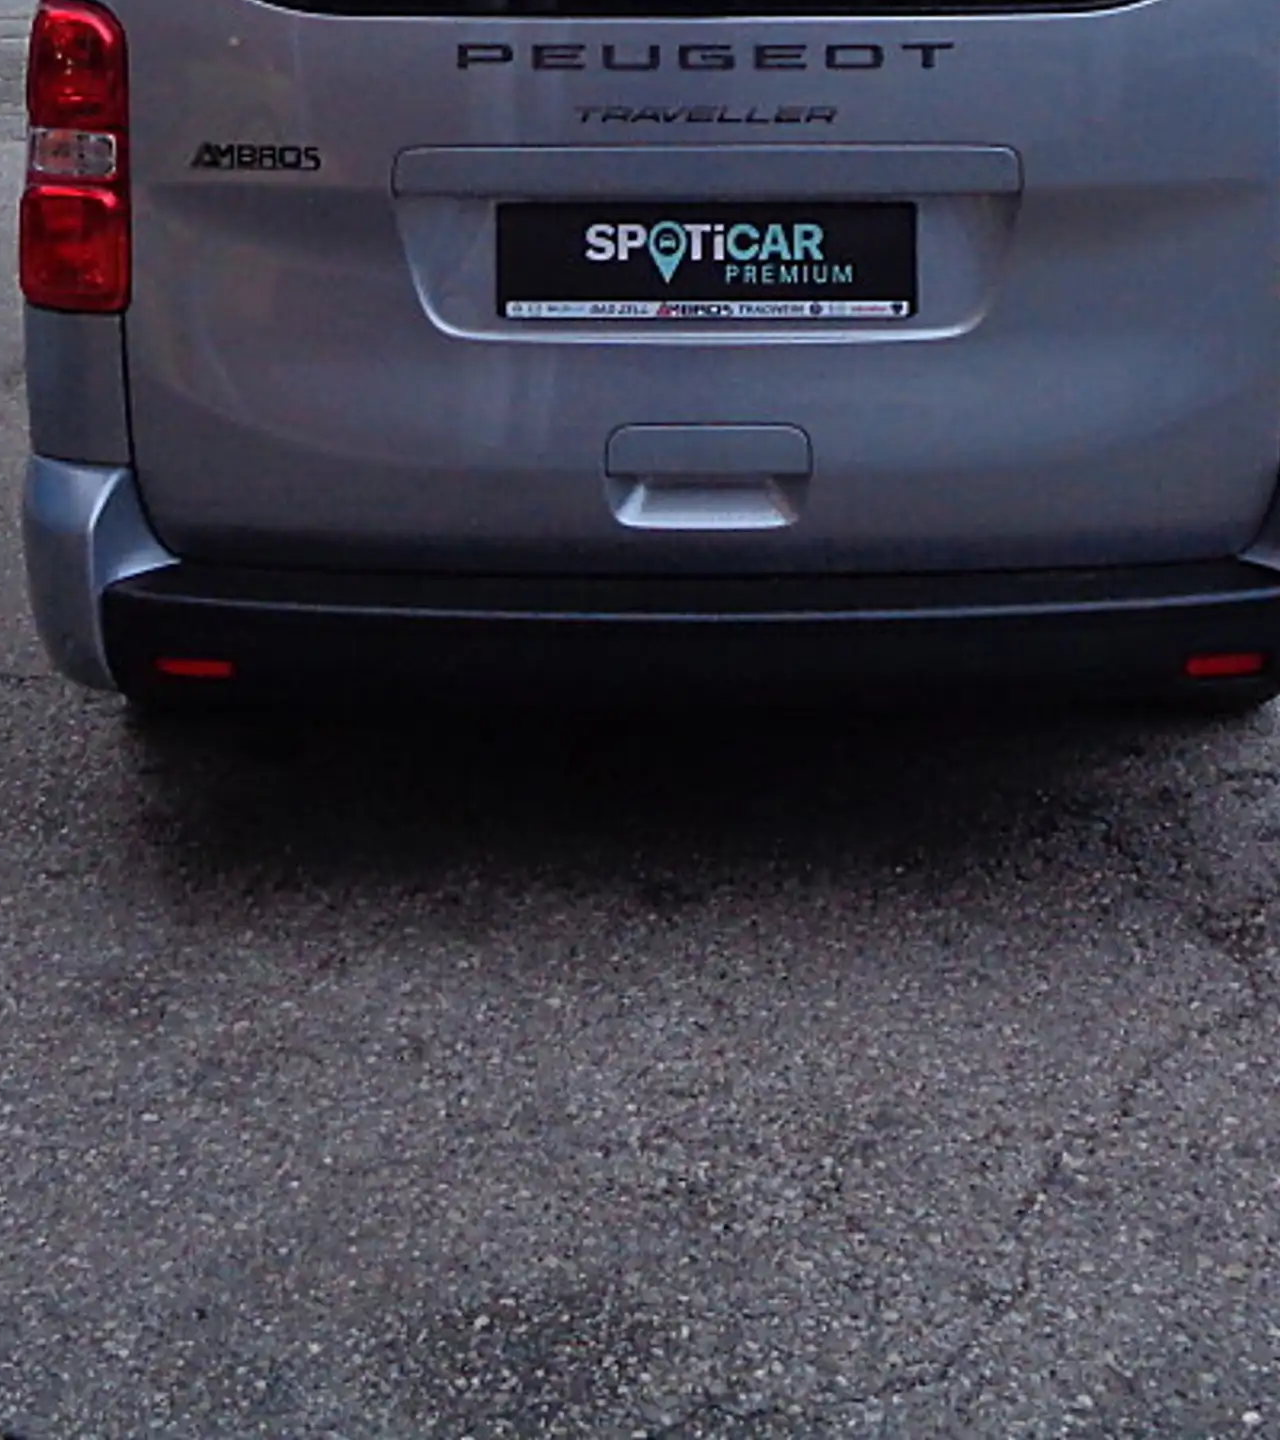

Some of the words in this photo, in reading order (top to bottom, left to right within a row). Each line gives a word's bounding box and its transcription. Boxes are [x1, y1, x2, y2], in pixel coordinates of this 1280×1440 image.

[456, 44, 955, 71] PEUGEOT
[574, 105, 838, 123] TRAVELLER
[190, 141, 322, 171] AMBROS
[725, 264, 854, 284] PREMIUM
